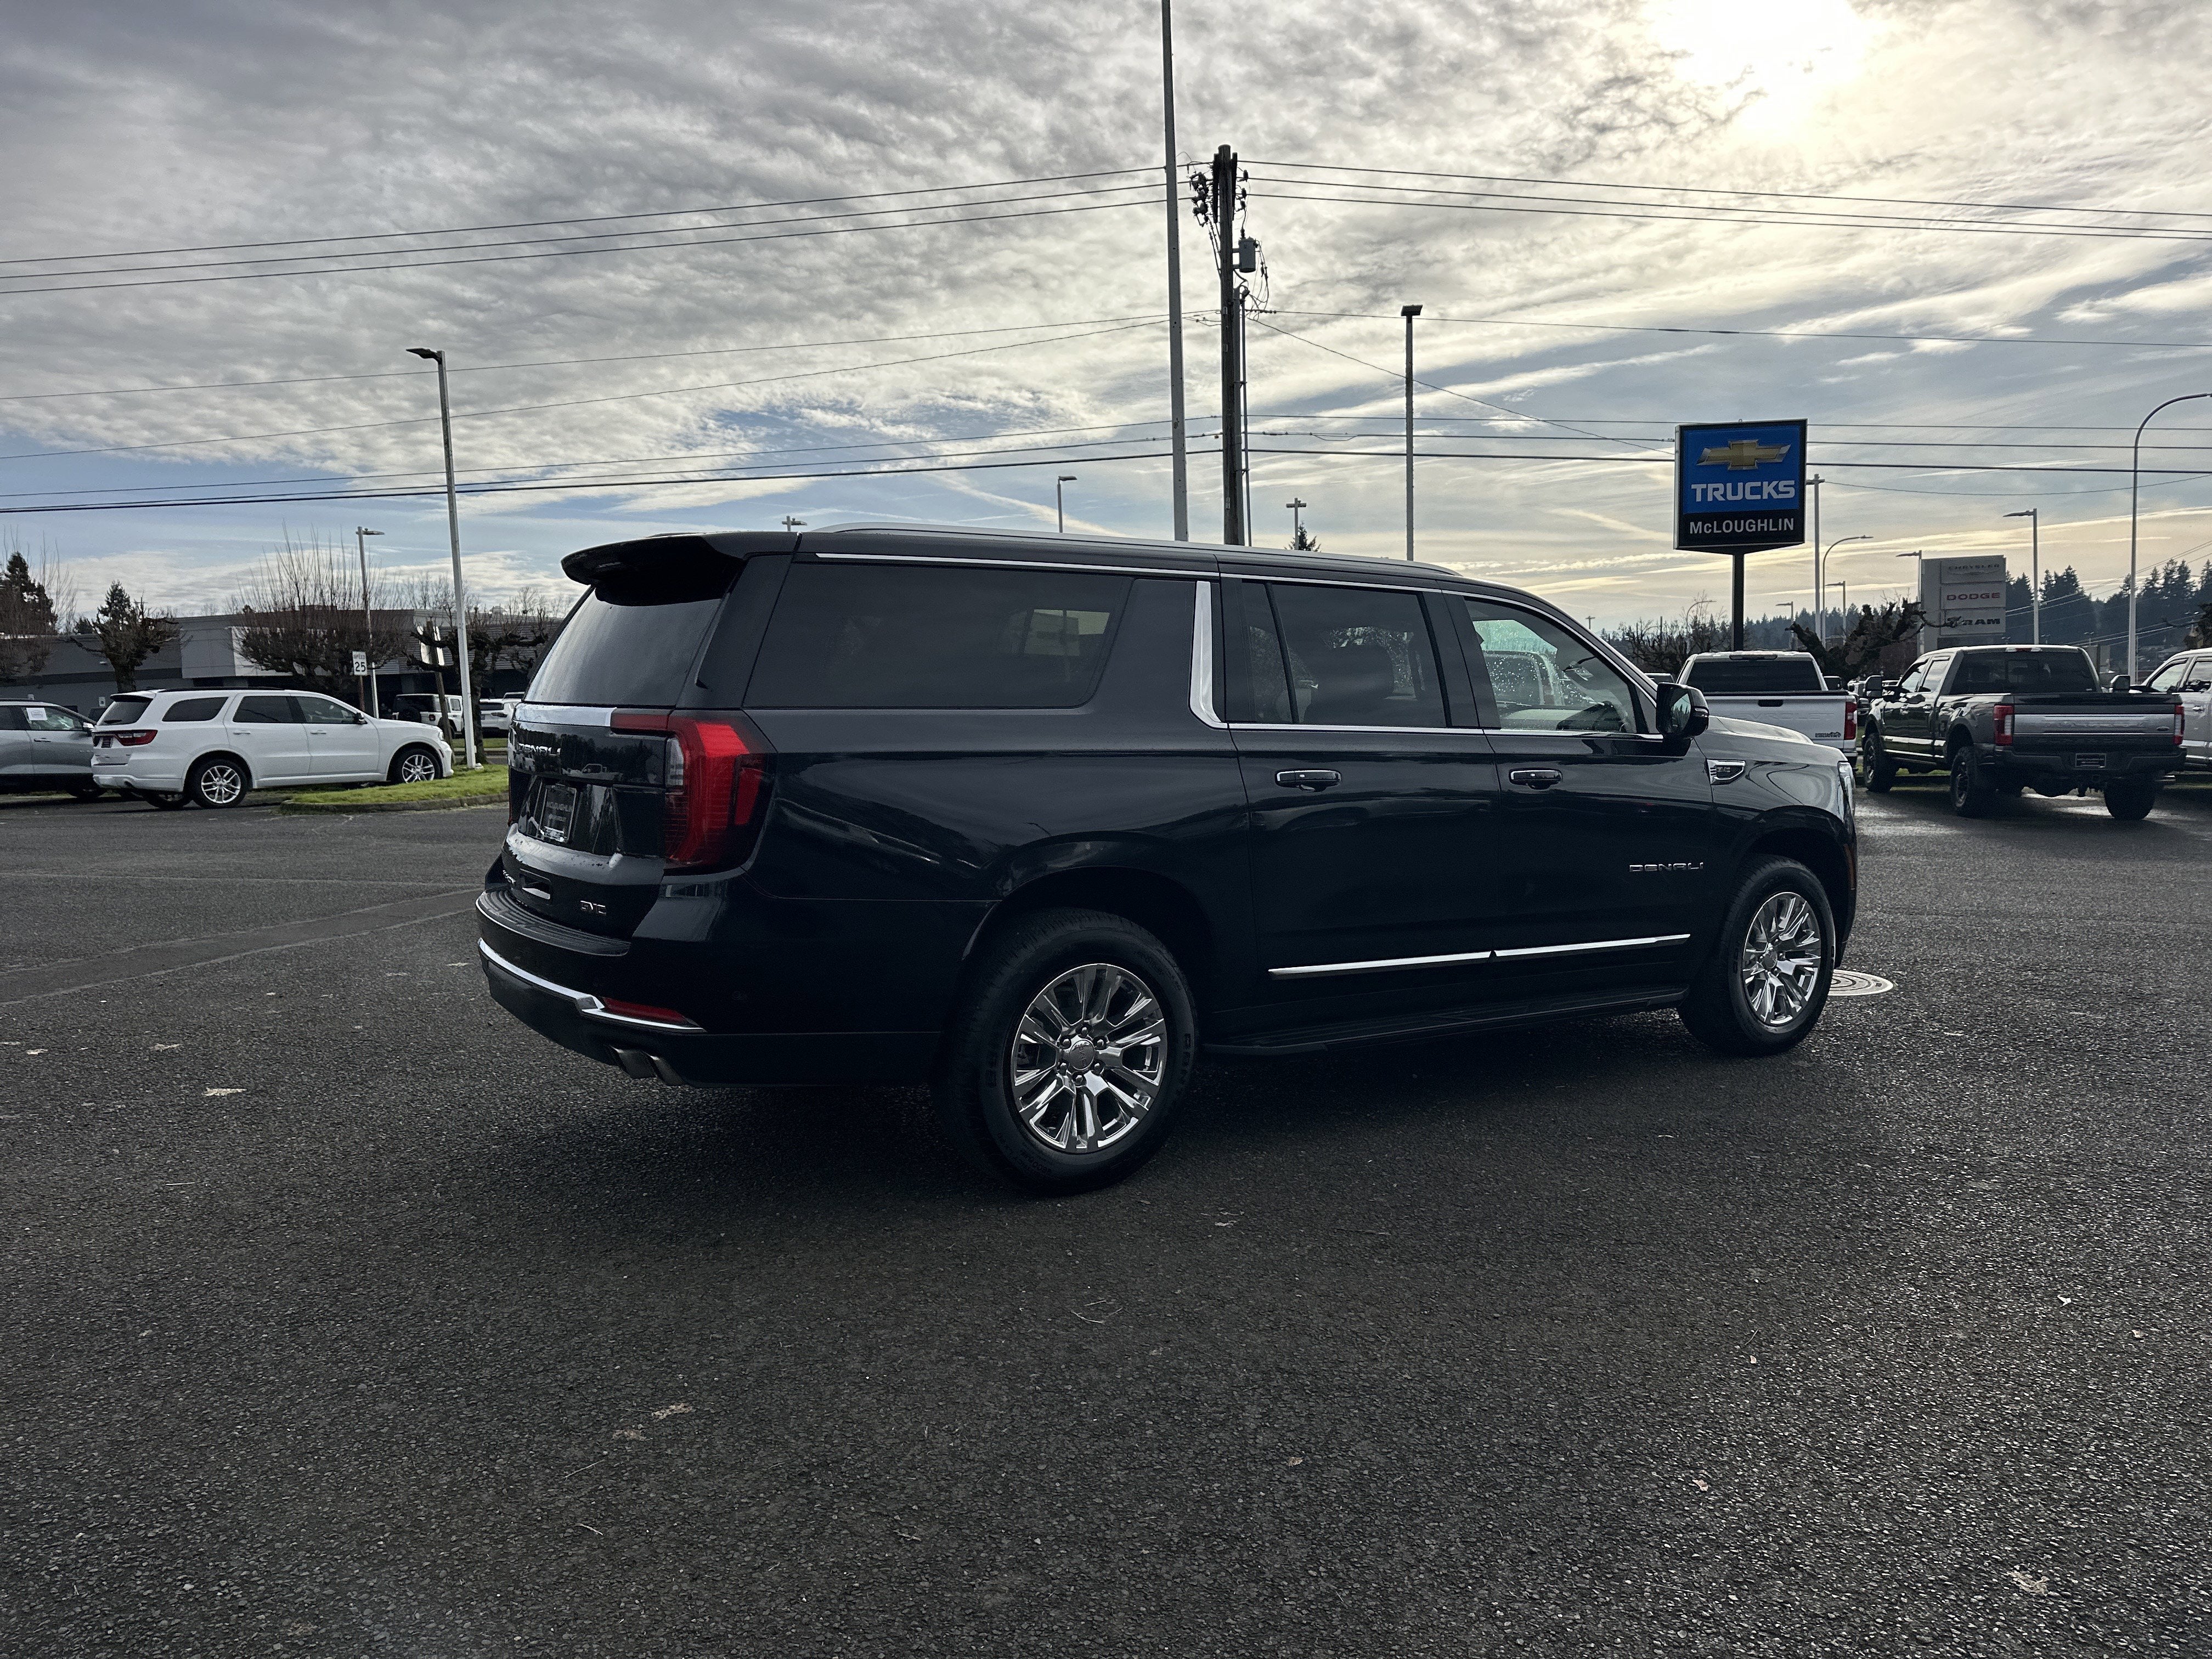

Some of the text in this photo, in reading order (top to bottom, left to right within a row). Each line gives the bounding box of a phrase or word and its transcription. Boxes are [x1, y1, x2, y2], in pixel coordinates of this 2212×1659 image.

[1691, 480, 1795, 502] TRUCKS
[1690, 518, 1794, 534] McLOUGHLIN
[354, 662, 366, 672] 25
[1629, 862, 1703, 873] DENALI
